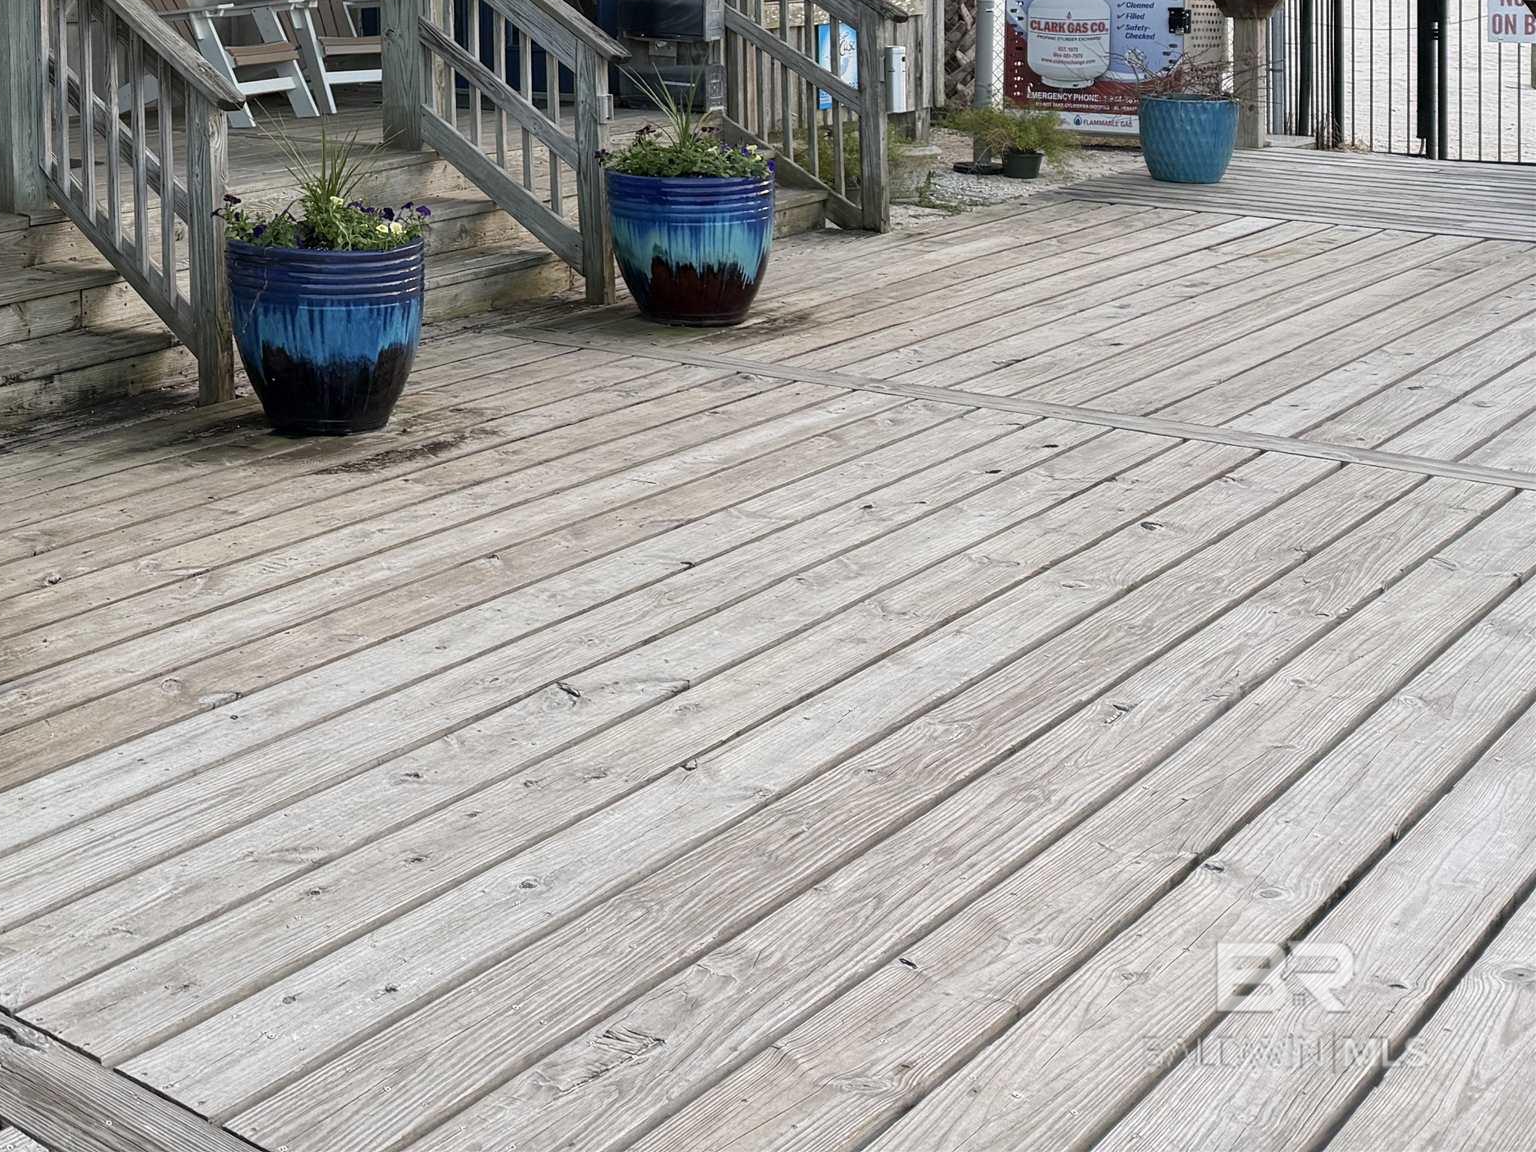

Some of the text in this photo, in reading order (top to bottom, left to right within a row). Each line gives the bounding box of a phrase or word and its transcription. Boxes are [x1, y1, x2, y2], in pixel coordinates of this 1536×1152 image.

[1030, 20, 1066, 33] CLARK
[1067, 22, 1089, 33] GAS
[1492, 14, 1517, 35] ON
